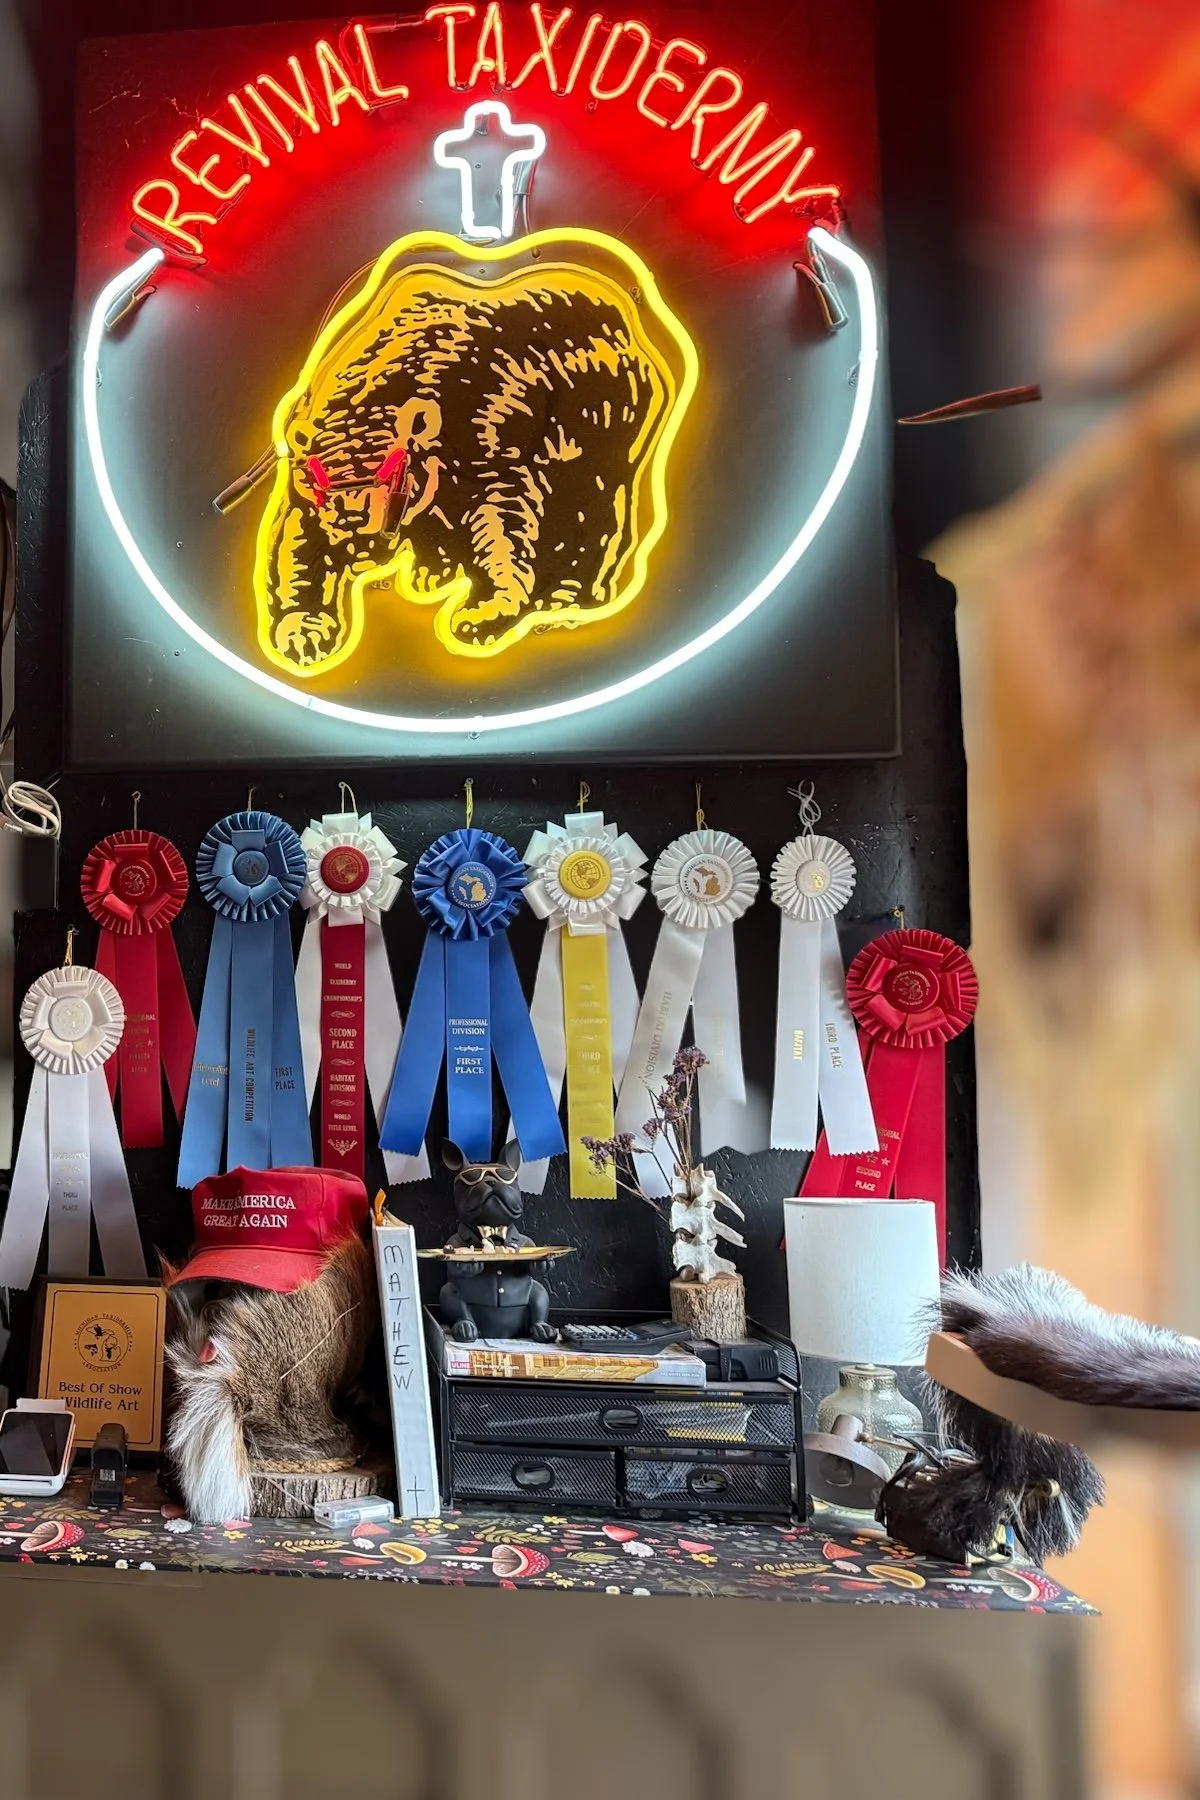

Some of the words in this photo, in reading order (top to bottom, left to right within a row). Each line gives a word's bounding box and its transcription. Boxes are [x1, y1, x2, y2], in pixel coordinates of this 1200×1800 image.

[132, 24, 408, 254] REVIVAL
[426, 1, 840, 224] TAXIDERMY
[448, 1019, 488, 1027] PROFESSIONAL
[329, 1028, 357, 1038] SECOND
[452, 1027, 485, 1036] DIVISION
[332, 1040, 355, 1050] PLACE
[456, 1057, 482, 1066] FIRST
[245, 1061, 255, 1076] ART
[275, 1067, 293, 1077] FIRST
[455, 1066, 484, 1075] PLACE
[275, 1080, 295, 1090] PLACE
[244, 1077, 255, 1122] COMPETITION
[855, 1179, 876, 1192] PLACE
[201, 1198, 234, 1211] MAKE
[233, 1194, 296, 1210] AMERICA
[203, 1214, 238, 1227] GREAT
[238, 1214, 288, 1228] AGAIN
[383, 1244, 414, 1391] MATHEW
[59, 1381, 85, 1393] Best
[90, 1382, 104, 1393] Of
[108, 1383, 143, 1396] Show
[117, 1399, 140, 1411] Art
